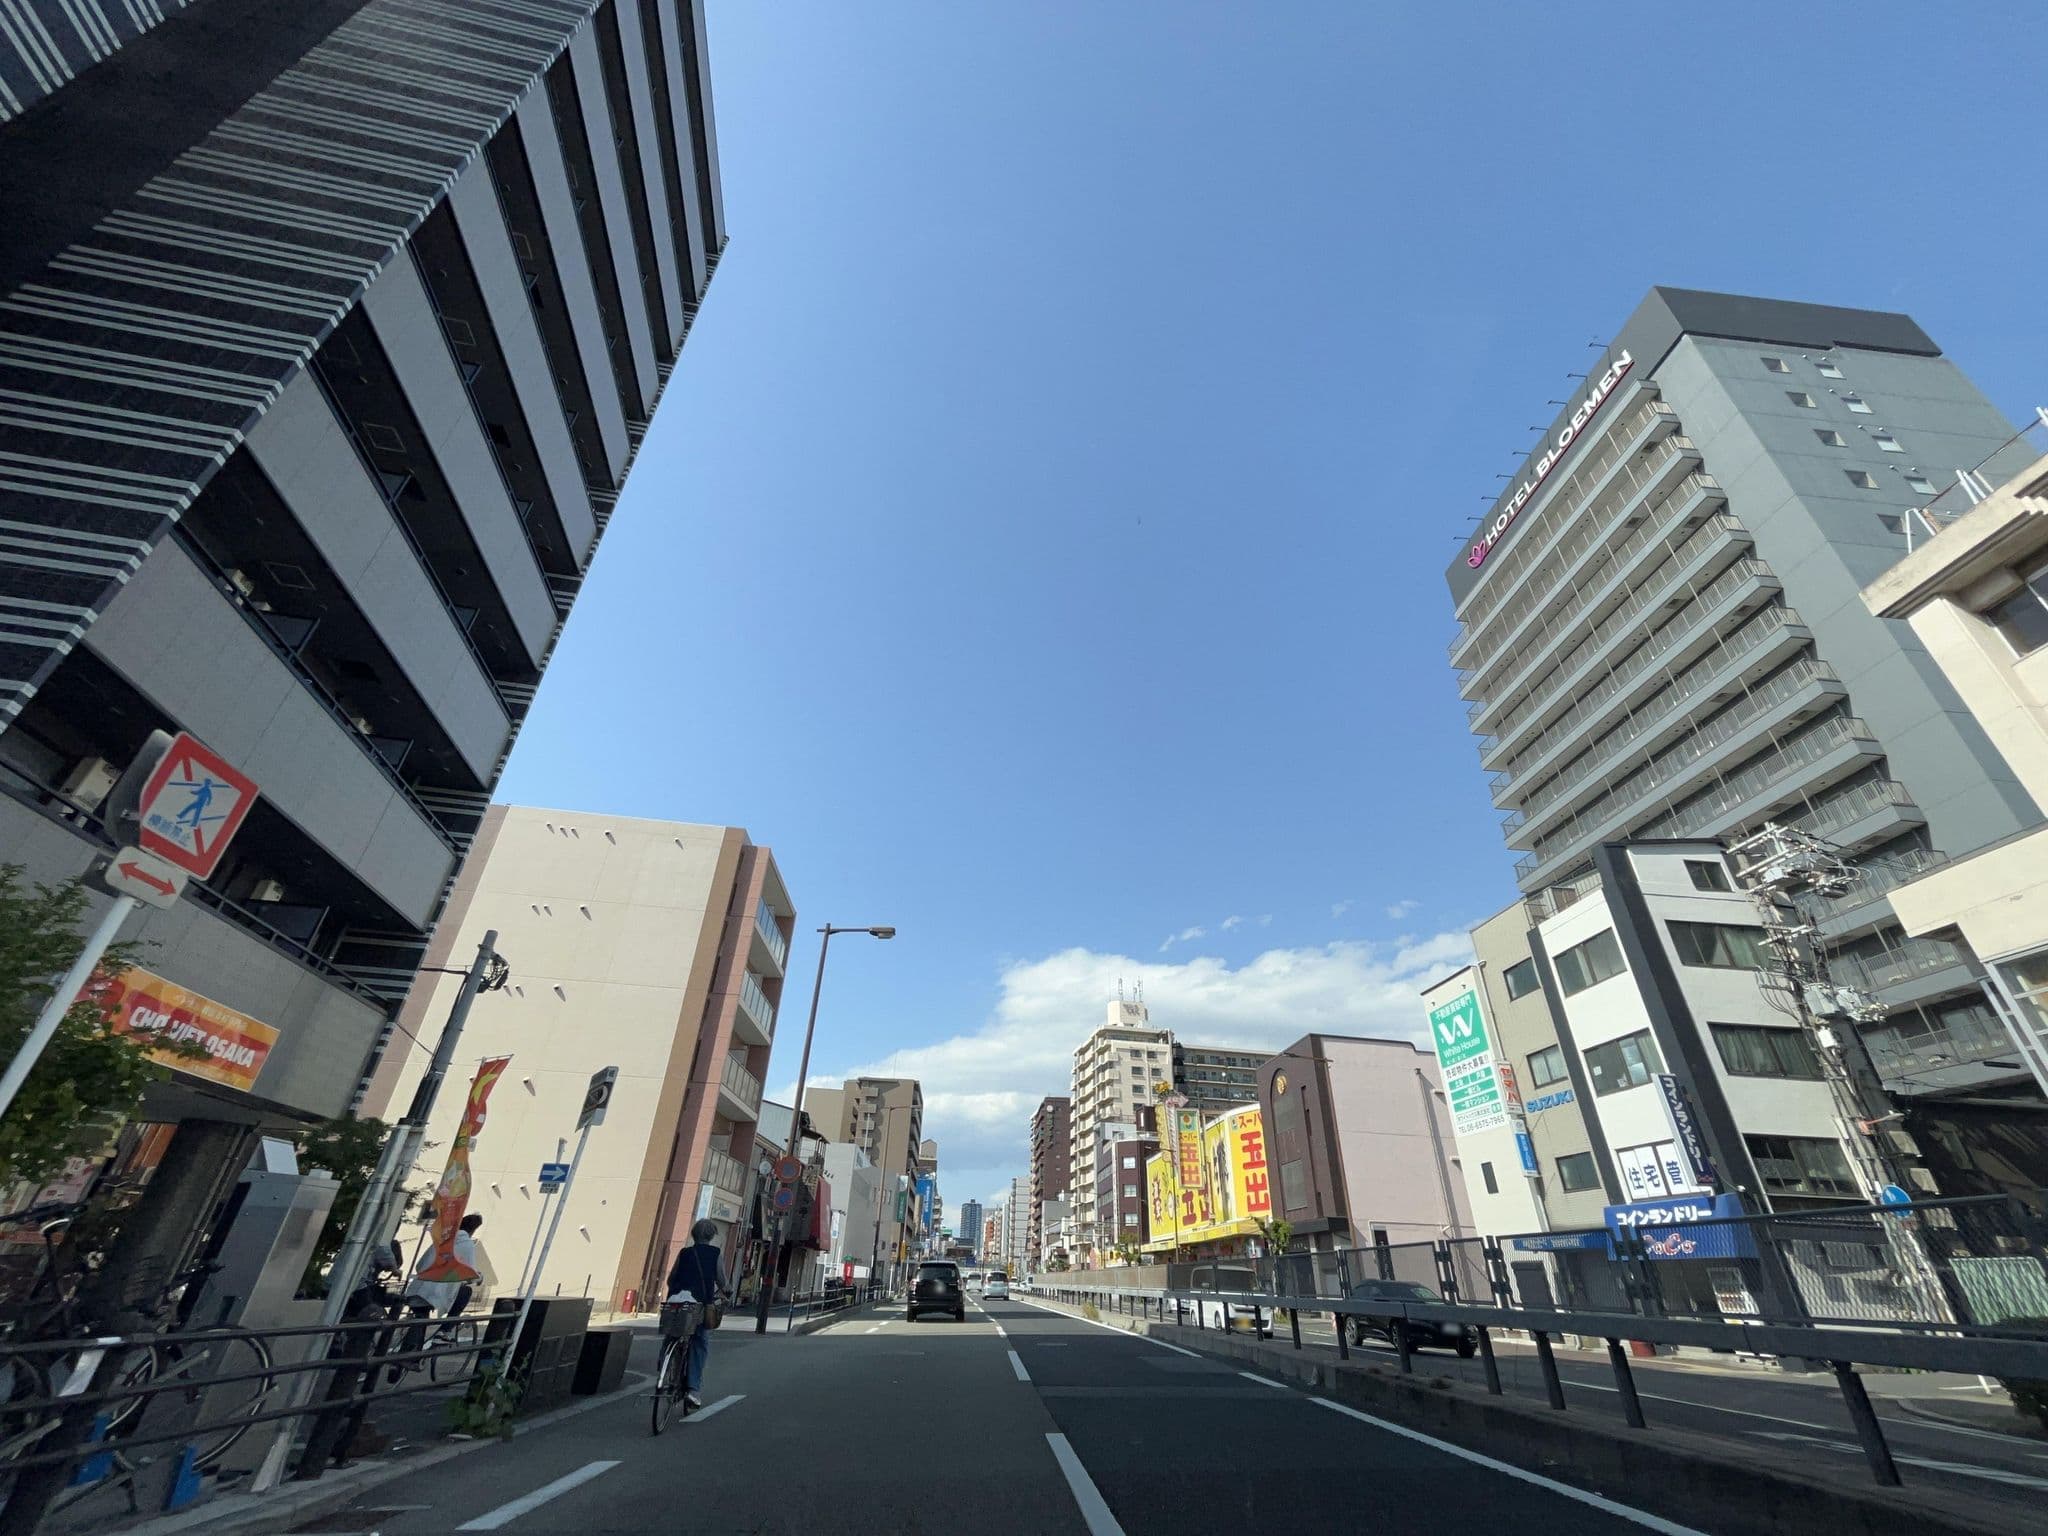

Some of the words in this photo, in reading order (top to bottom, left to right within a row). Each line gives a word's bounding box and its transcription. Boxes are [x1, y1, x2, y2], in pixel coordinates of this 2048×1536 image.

[1485, 480, 1538, 546] HOTEL
[1536, 349, 1634, 478] BLOEMEN
[205, 1035, 257, 1069] OSAKA
[1443, 1047, 1461, 1059] White
[1461, 1036, 1480, 1051] House
[1526, 1089, 1574, 1113] SUZUKI
[1178, 1132, 1198, 1142] スーパー
[1663, 1077, 1704, 1172] コインランドリー
[1180, 1142, 1201, 1185] 玉出
[1240, 1131, 1270, 1212] 玉出
[1616, 1204, 1712, 1226] コインランドリー
